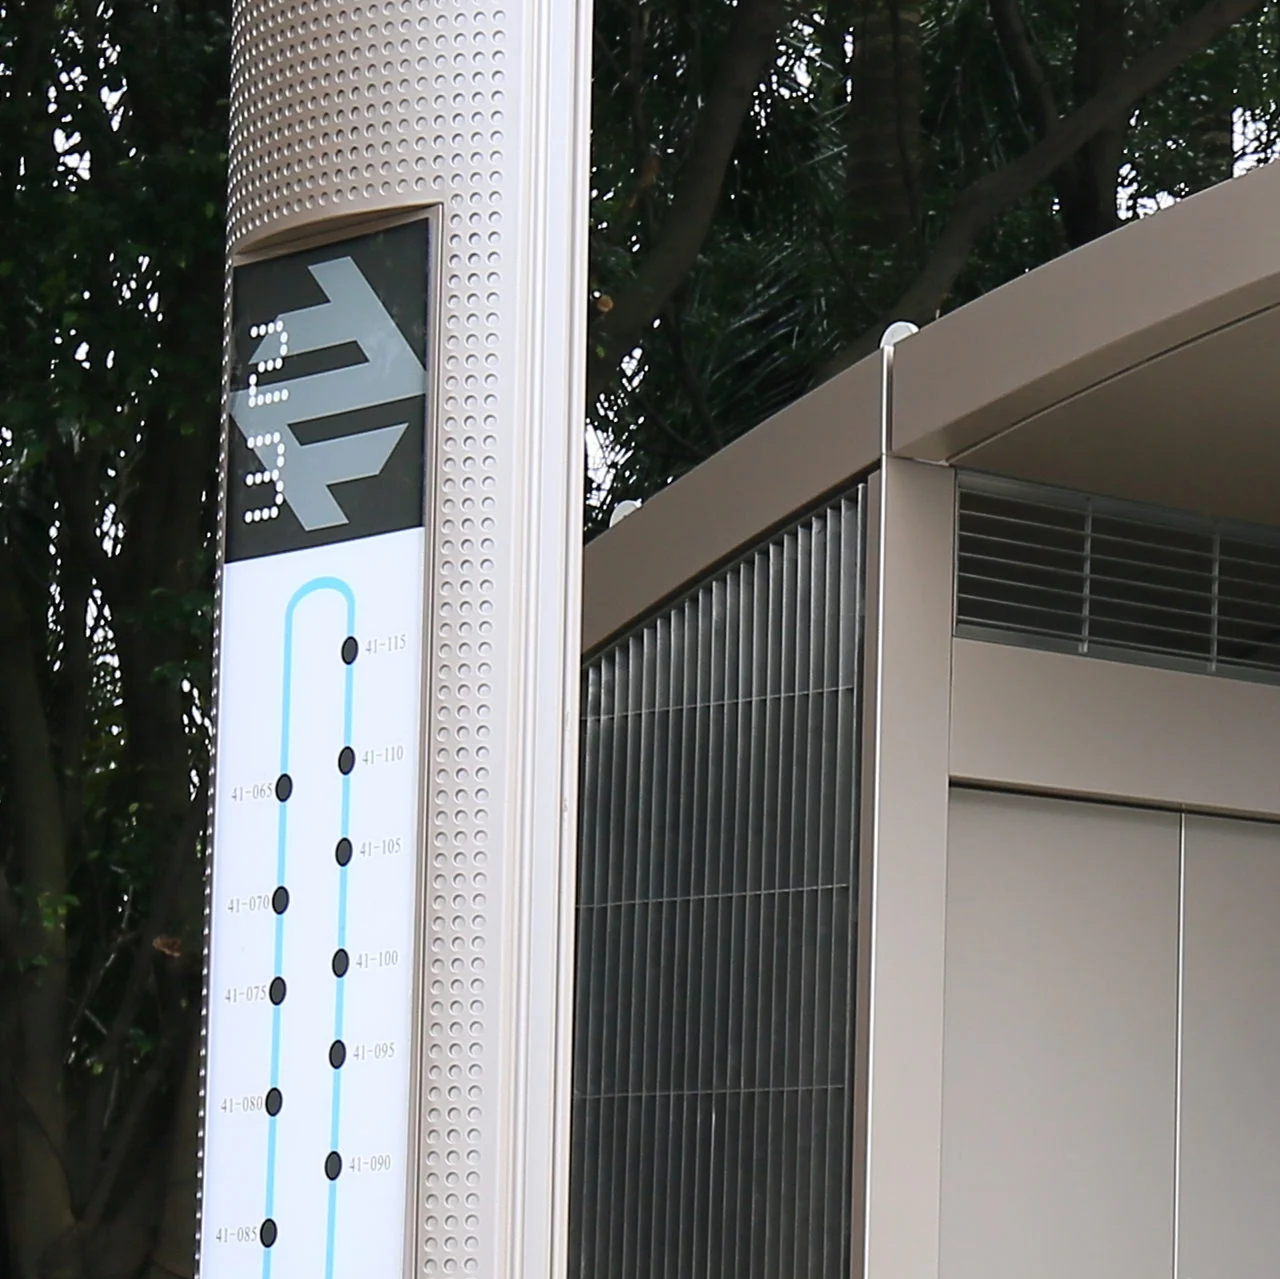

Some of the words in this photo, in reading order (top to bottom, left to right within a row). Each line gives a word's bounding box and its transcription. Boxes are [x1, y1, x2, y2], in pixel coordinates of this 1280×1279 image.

[365, 634, 406, 654] 41-115
[362, 745, 403, 765] 41-110
[231, 782, 273, 801] 41-065
[360, 838, 401, 857] 41-105
[228, 895, 269, 913] 41-070
[356, 950, 398, 968] 41-100
[225, 985, 267, 1003] 41-075
[353, 1042, 395, 1060] 41-095
[221, 1095, 263, 1113] 41-080
[349, 1154, 391, 1172] 41-090
[216, 1226, 257, 1243] 41-085
